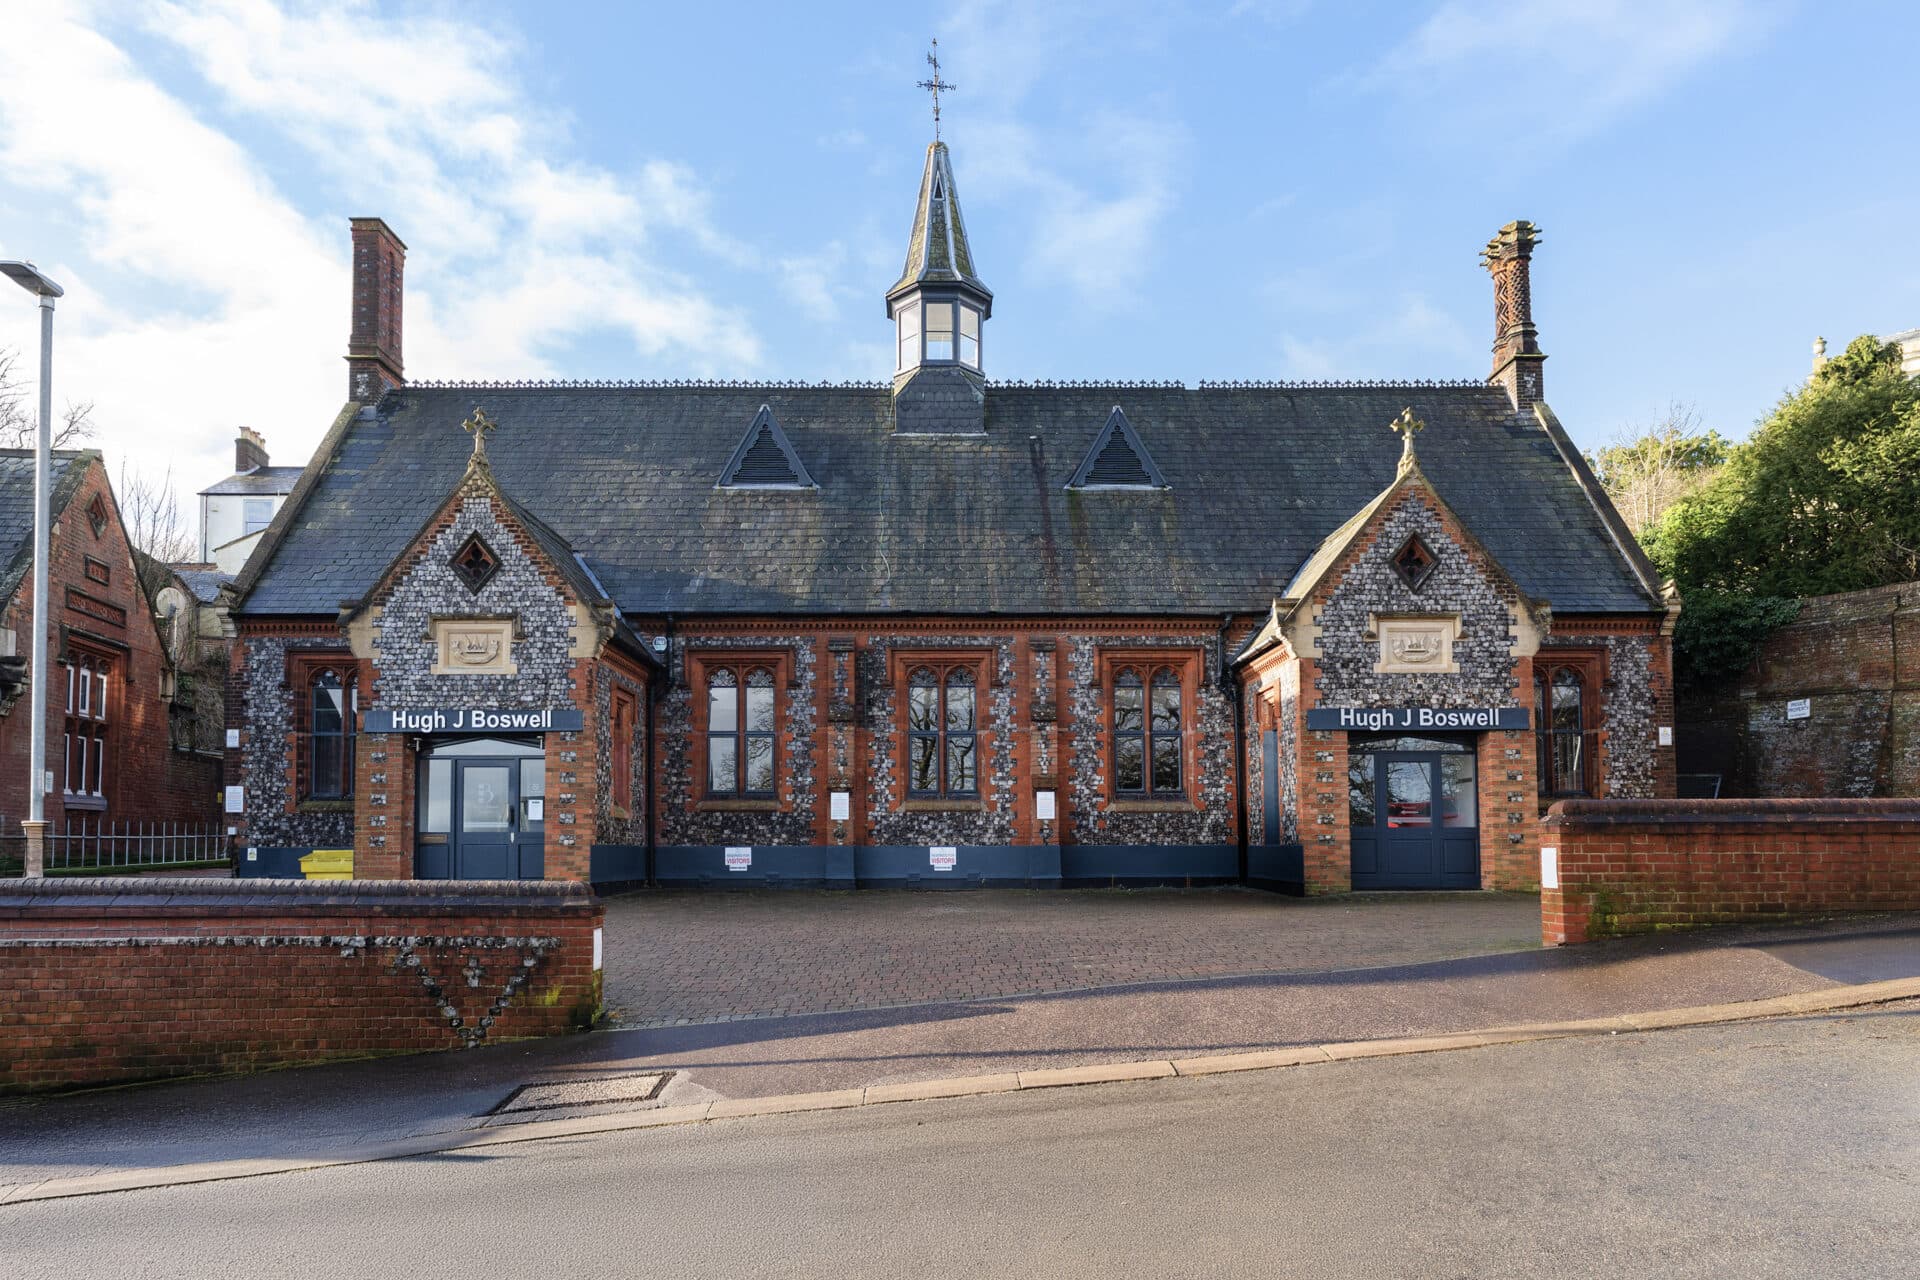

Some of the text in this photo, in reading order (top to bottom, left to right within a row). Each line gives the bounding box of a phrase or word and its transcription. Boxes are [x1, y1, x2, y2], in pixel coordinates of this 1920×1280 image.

[392, 710, 552, 733] Hugh J Boswell
[1340, 708, 1499, 731] Hugh J Boswell
